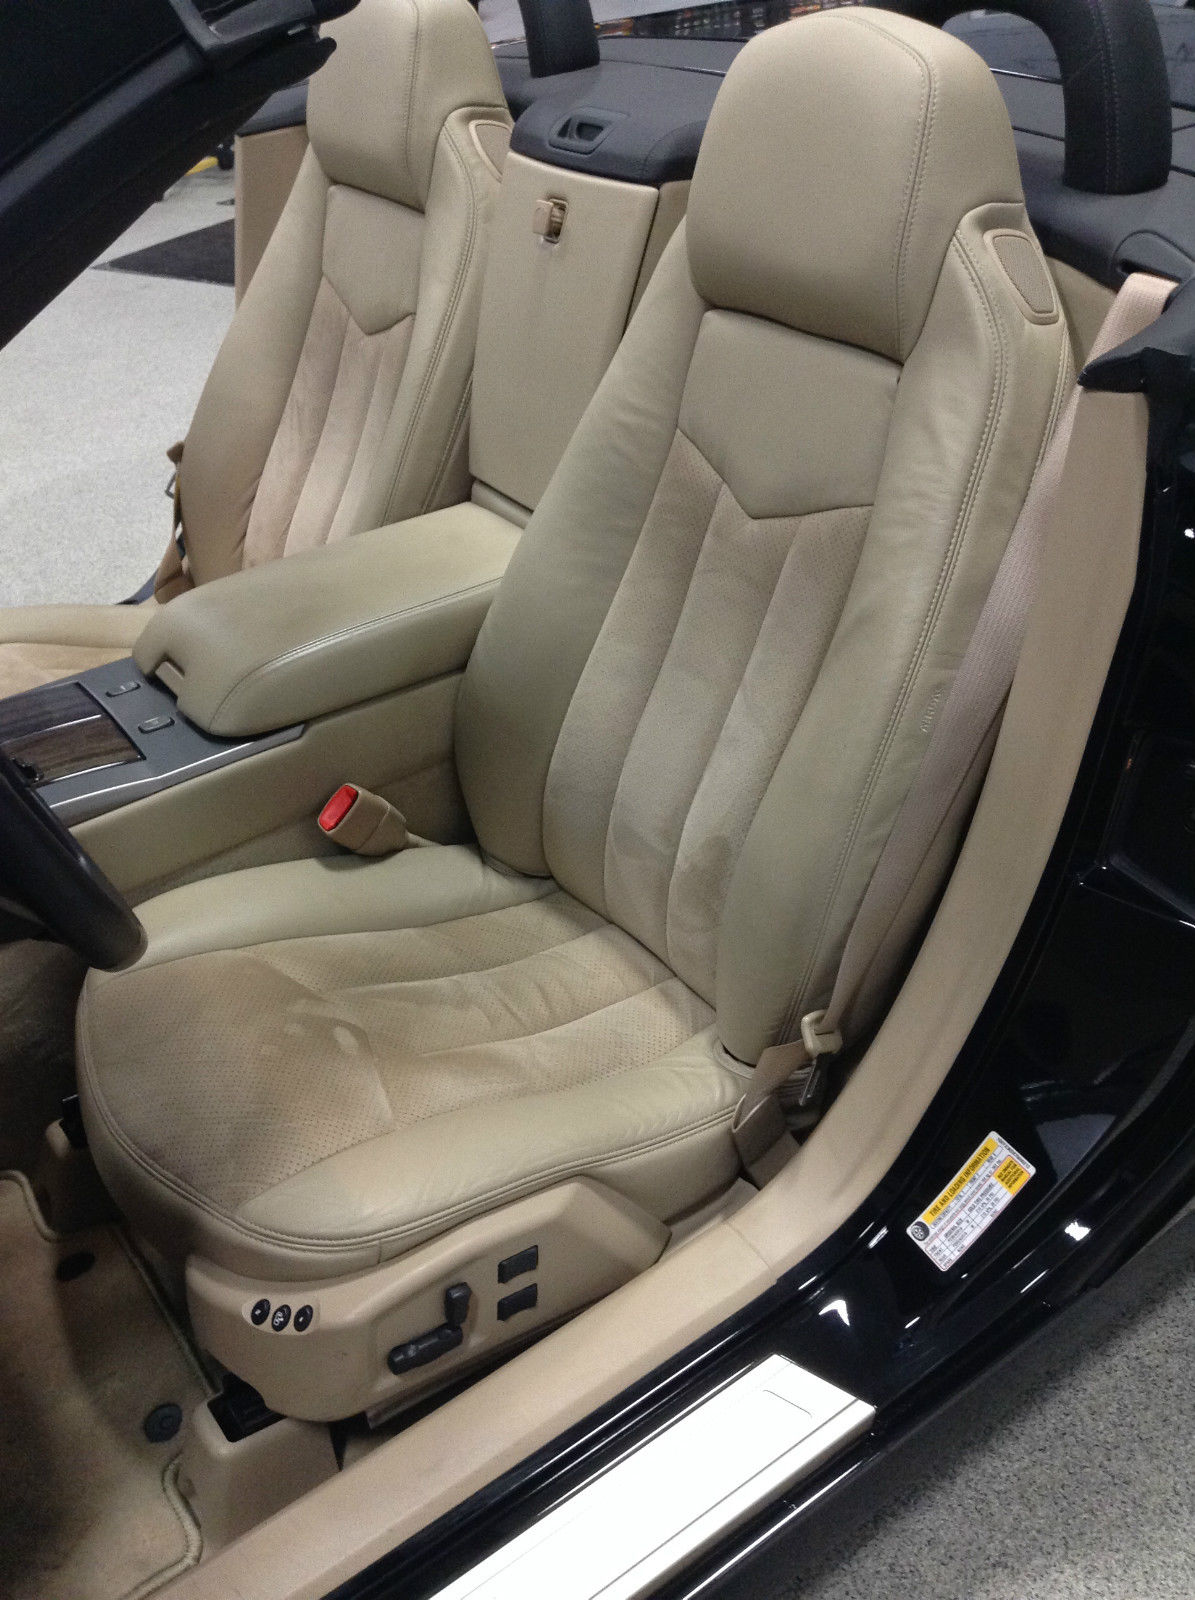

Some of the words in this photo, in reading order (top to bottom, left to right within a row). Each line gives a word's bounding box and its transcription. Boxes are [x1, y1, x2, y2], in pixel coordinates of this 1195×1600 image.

[929, 1203, 941, 1217] TIRE
[938, 1192, 950, 1206] AND
[948, 1174, 966, 1197] LOADING
[963, 1147, 991, 1178] INFORMATION
